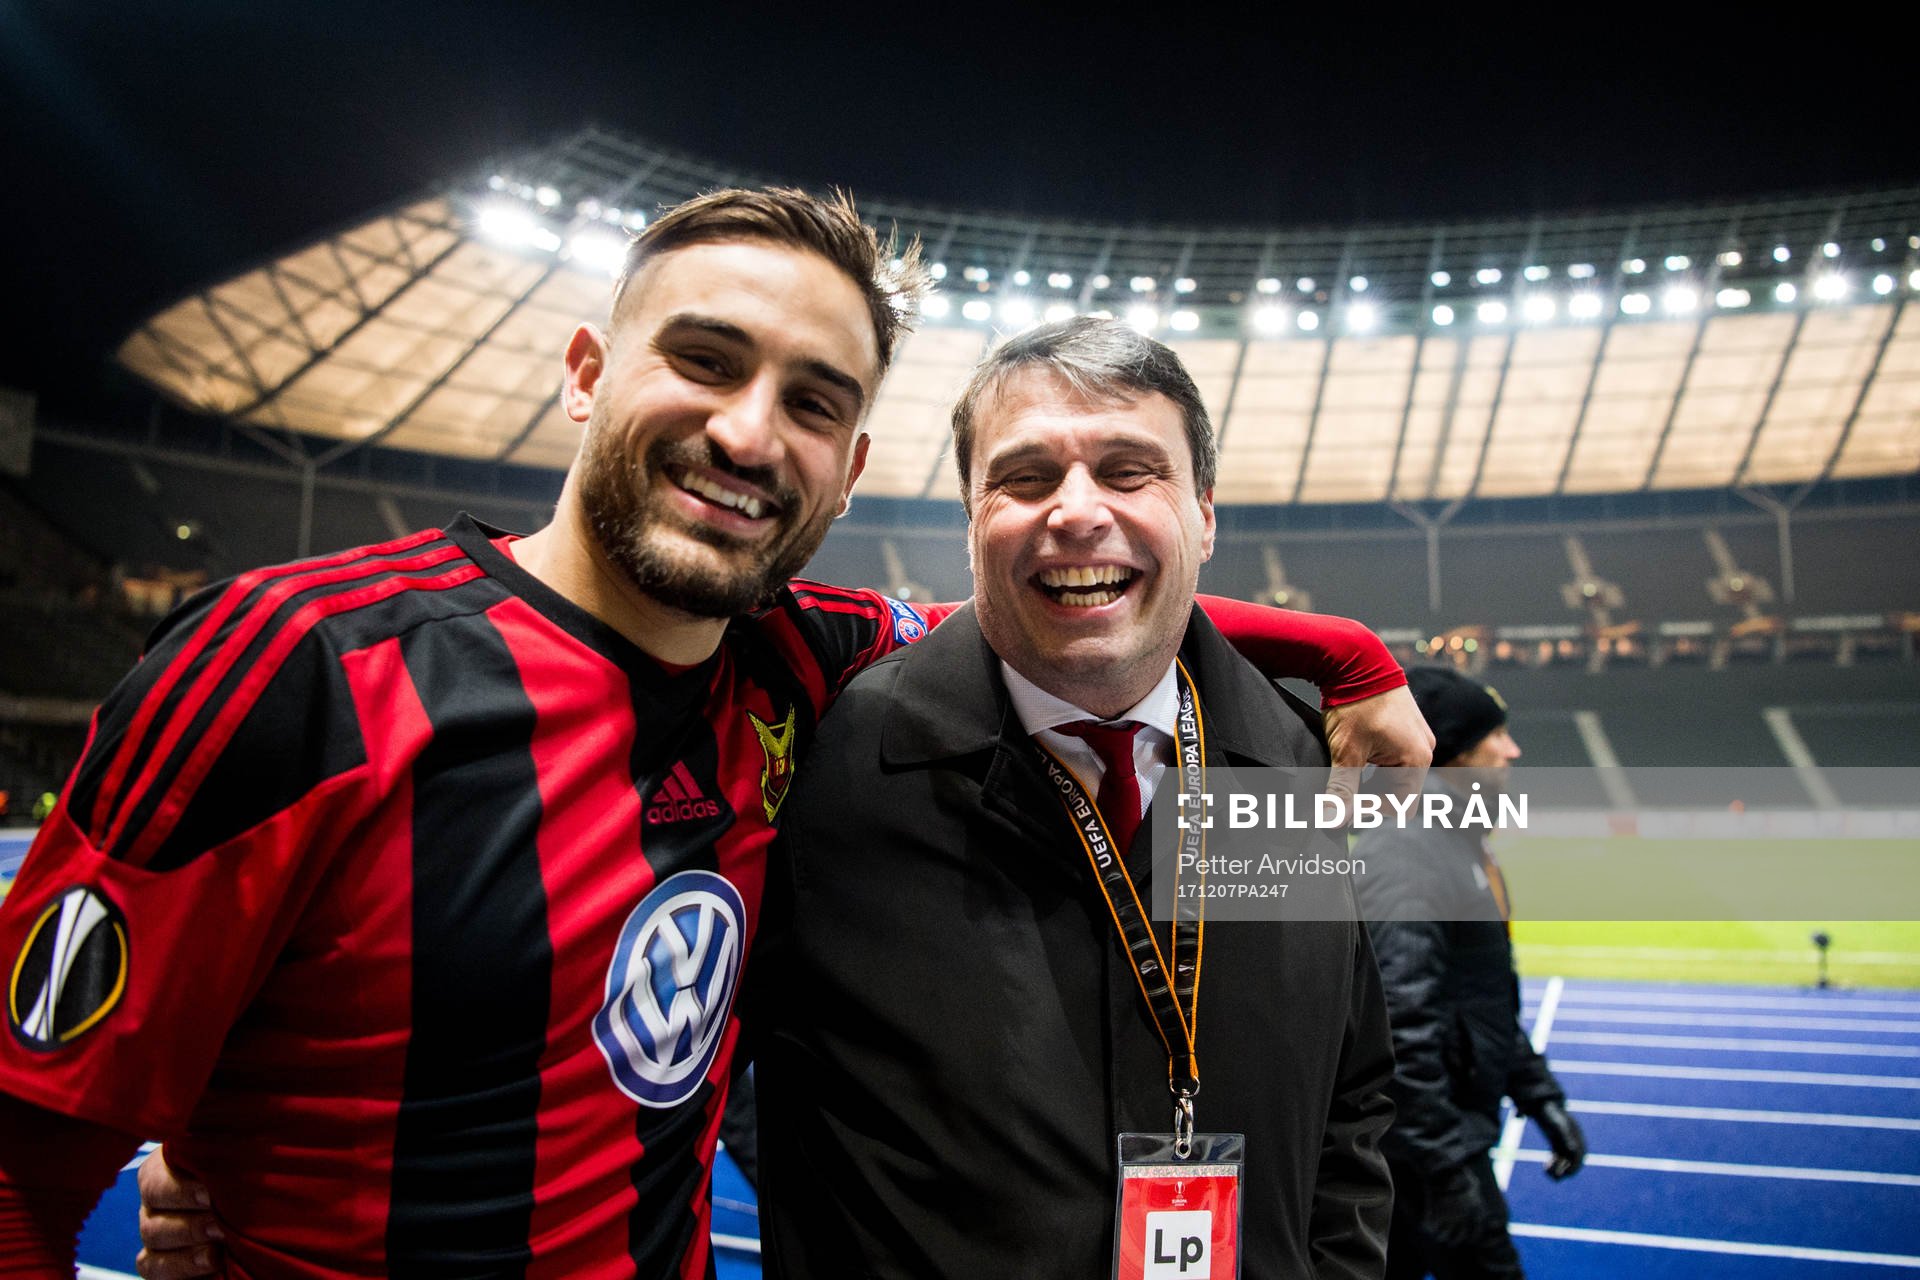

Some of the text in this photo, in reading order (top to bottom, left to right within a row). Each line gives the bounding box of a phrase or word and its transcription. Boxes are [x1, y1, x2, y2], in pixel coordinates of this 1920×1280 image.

[1180, 686, 1202, 860] UEFA EUROPA LEAGUE
[647, 798, 720, 824] adidas
[1048, 762, 1113, 868] UEFA EUROPA
[1154, 1228, 1203, 1272] Lp
